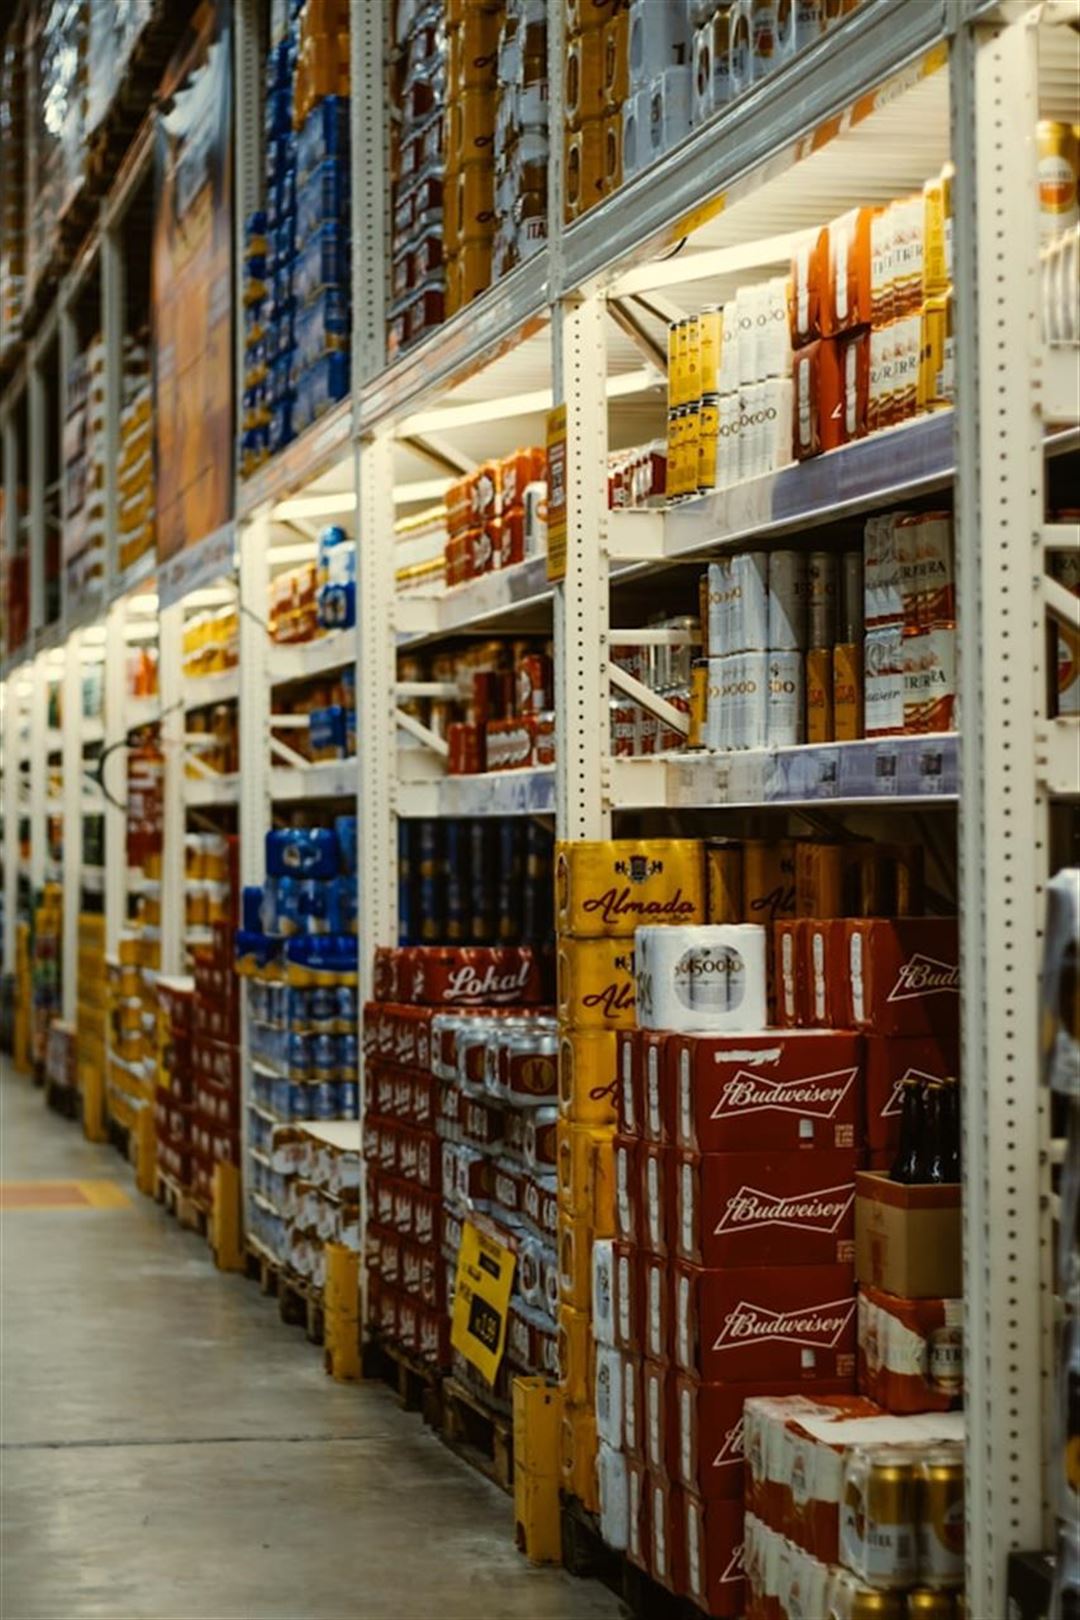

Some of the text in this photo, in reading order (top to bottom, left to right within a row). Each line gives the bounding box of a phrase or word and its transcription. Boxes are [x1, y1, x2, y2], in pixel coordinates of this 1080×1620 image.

[582, 887, 696, 924] Almada
[443, 960, 530, 1000] Lokal
[723, 1083, 843, 1106] Budweiser
[726, 1195, 846, 1221] Budweiser
[724, 1313, 845, 1337] Budweiser
